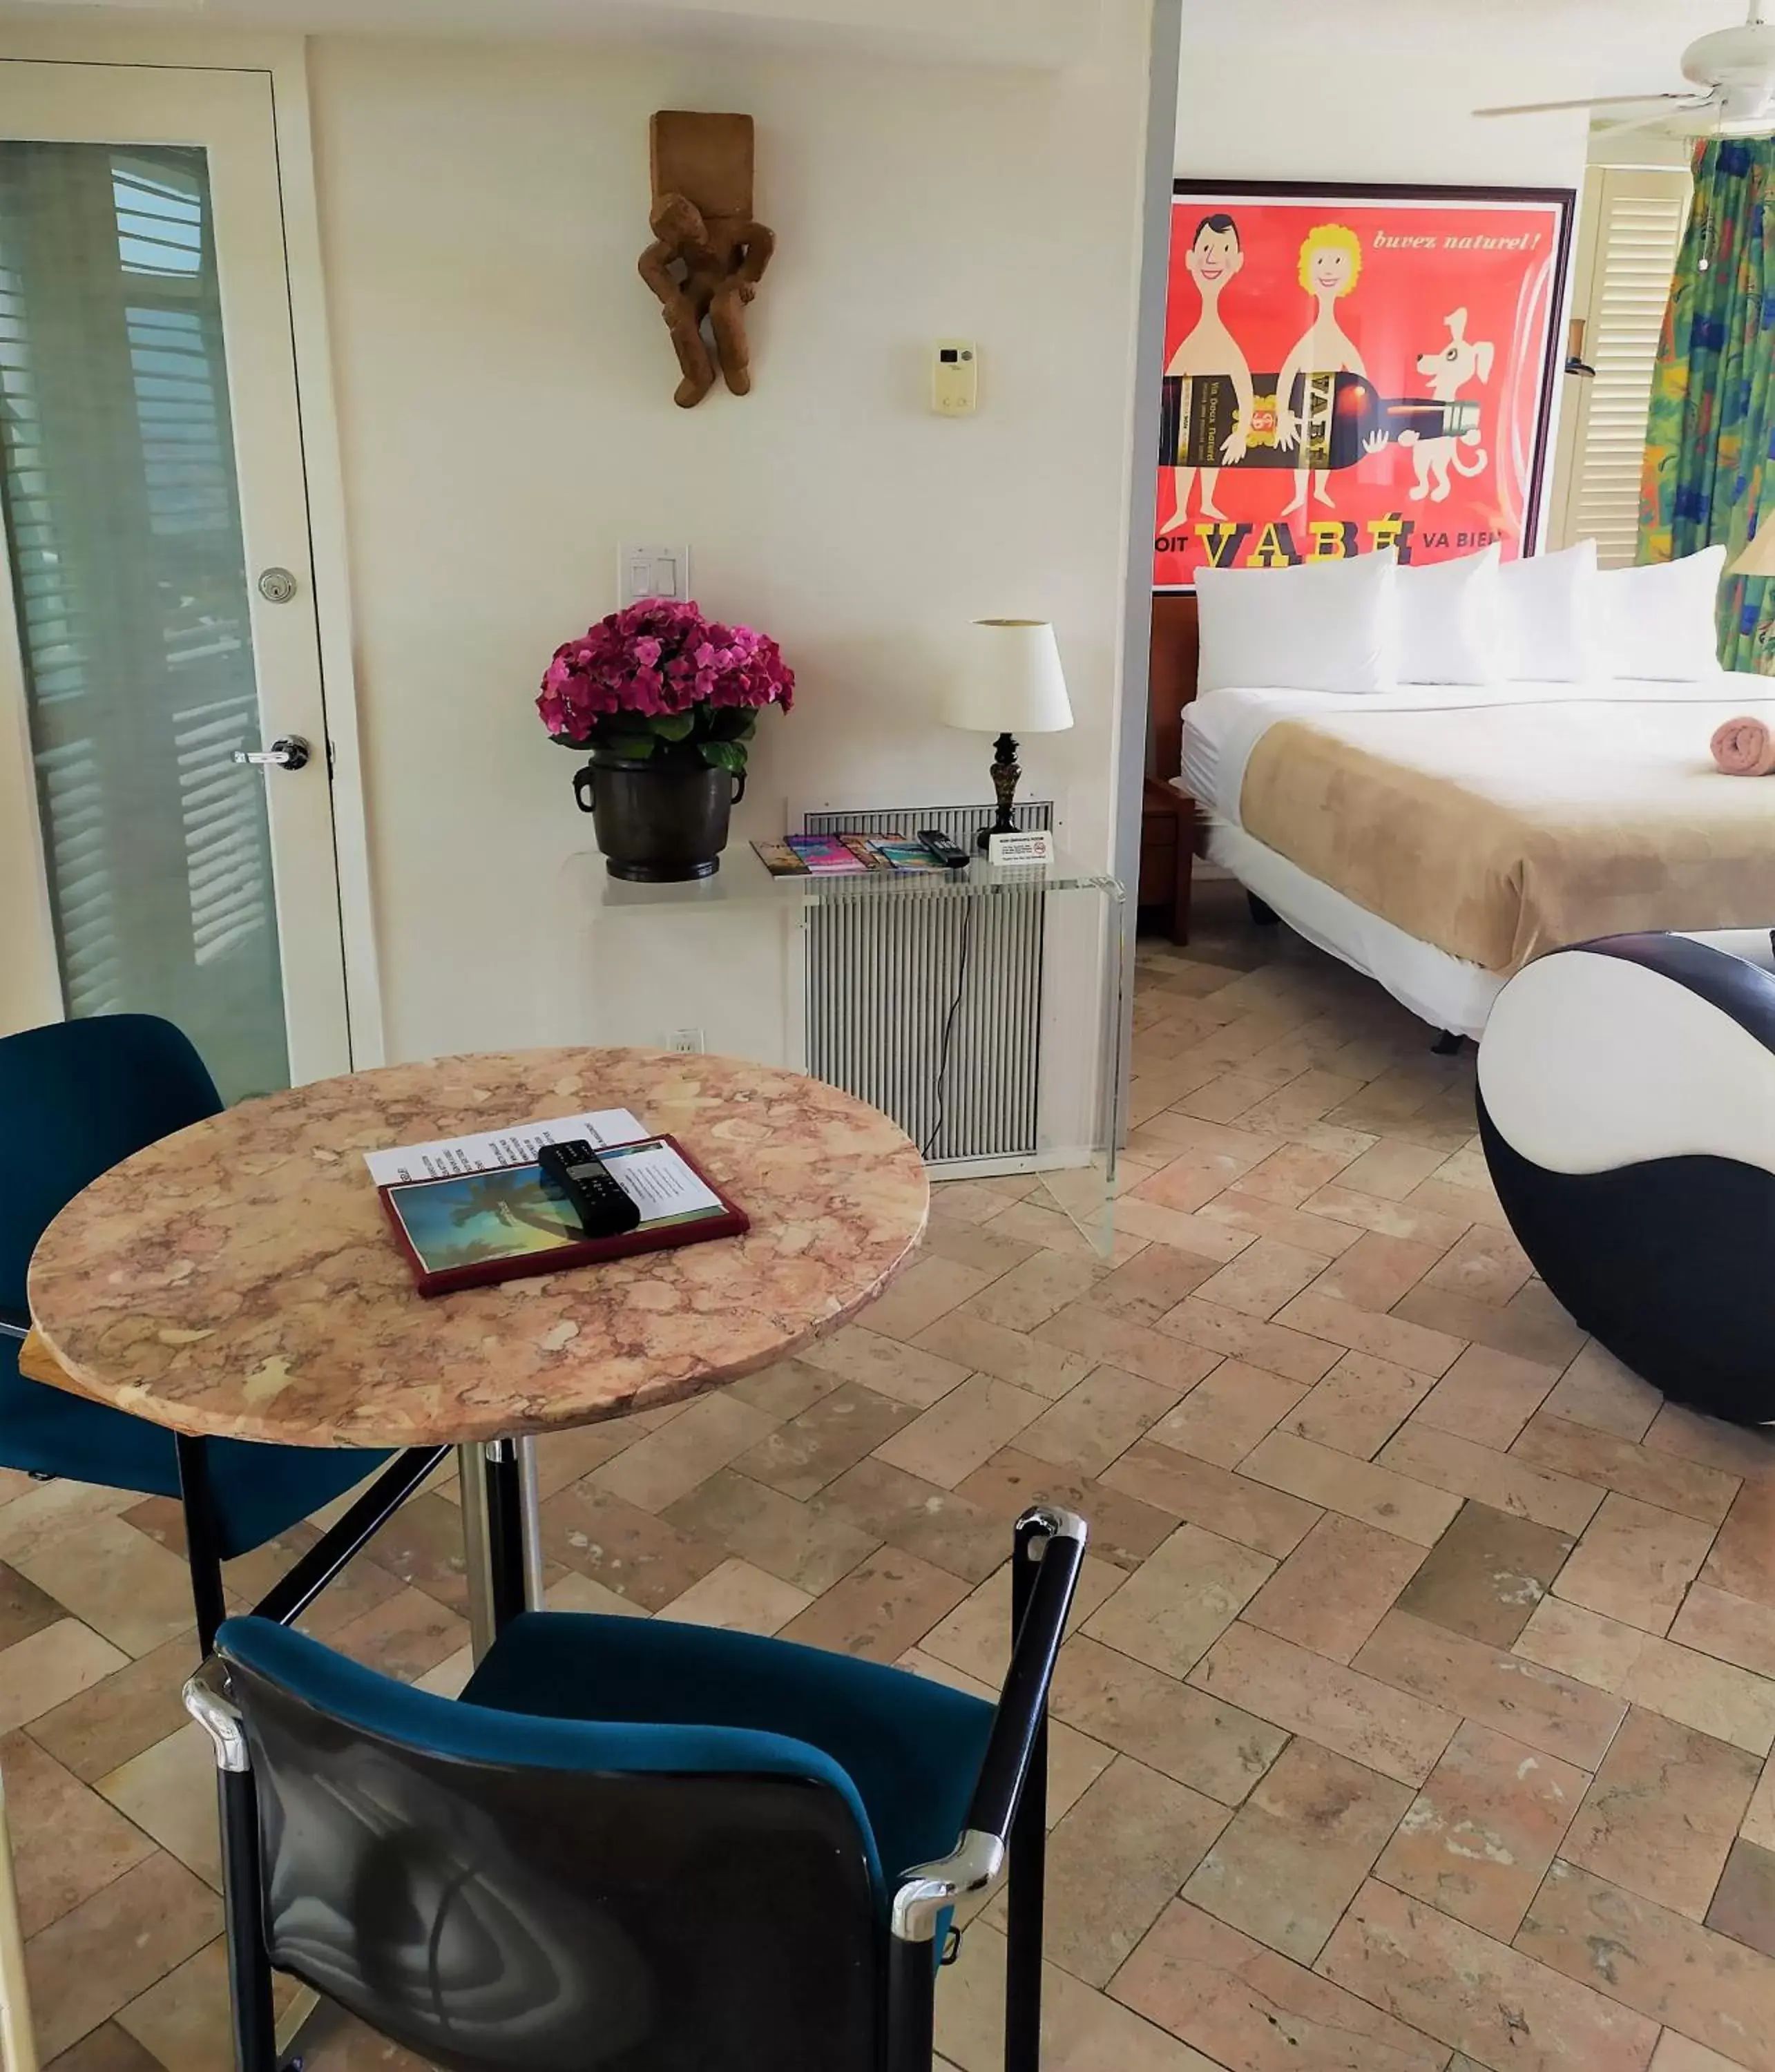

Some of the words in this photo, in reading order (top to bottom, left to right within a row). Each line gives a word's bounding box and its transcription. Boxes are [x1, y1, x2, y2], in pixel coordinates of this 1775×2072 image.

[1372, 230, 1437, 249] buvez
[1155, 536, 1189, 553] OIT
[1194, 512, 1414, 568] VABÉ
[1423, 533, 1450, 548] VA
